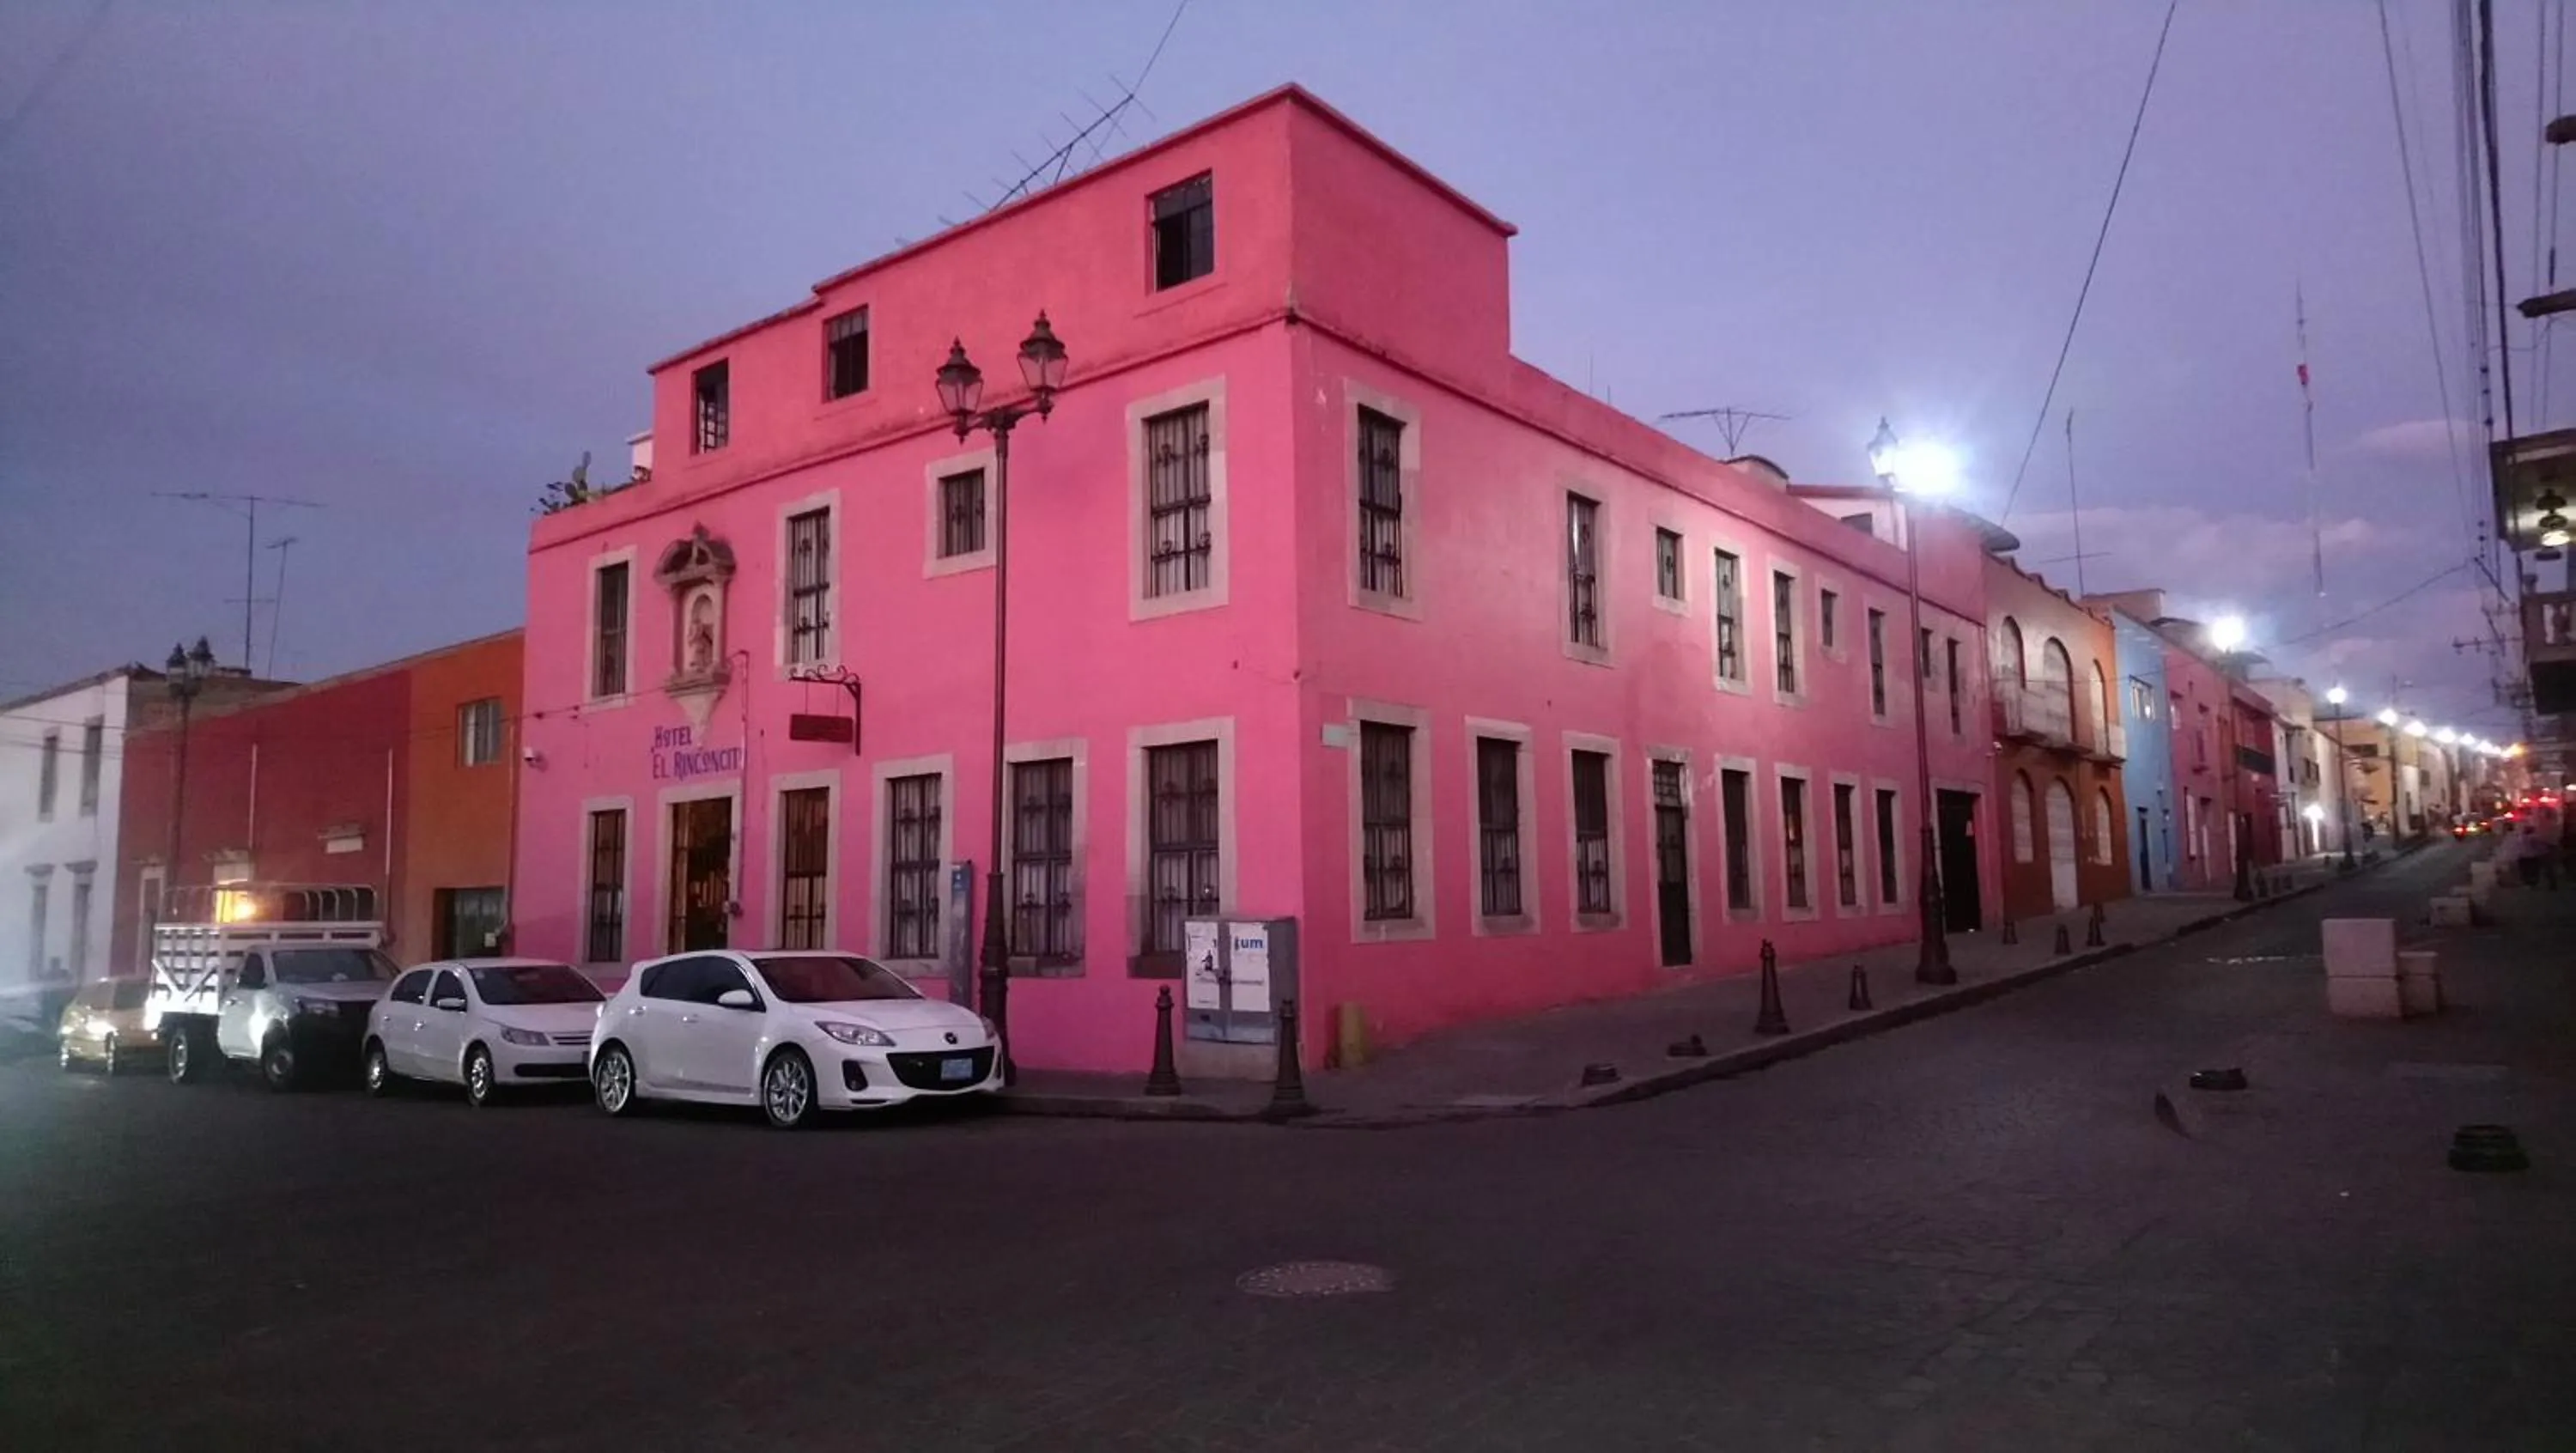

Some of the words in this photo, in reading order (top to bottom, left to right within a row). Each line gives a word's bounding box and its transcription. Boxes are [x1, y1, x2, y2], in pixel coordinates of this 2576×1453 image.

[654, 726, 692, 748] HOTEL
[653, 754, 671, 779] EL
[673, 746, 742, 781] RINCONCIT
